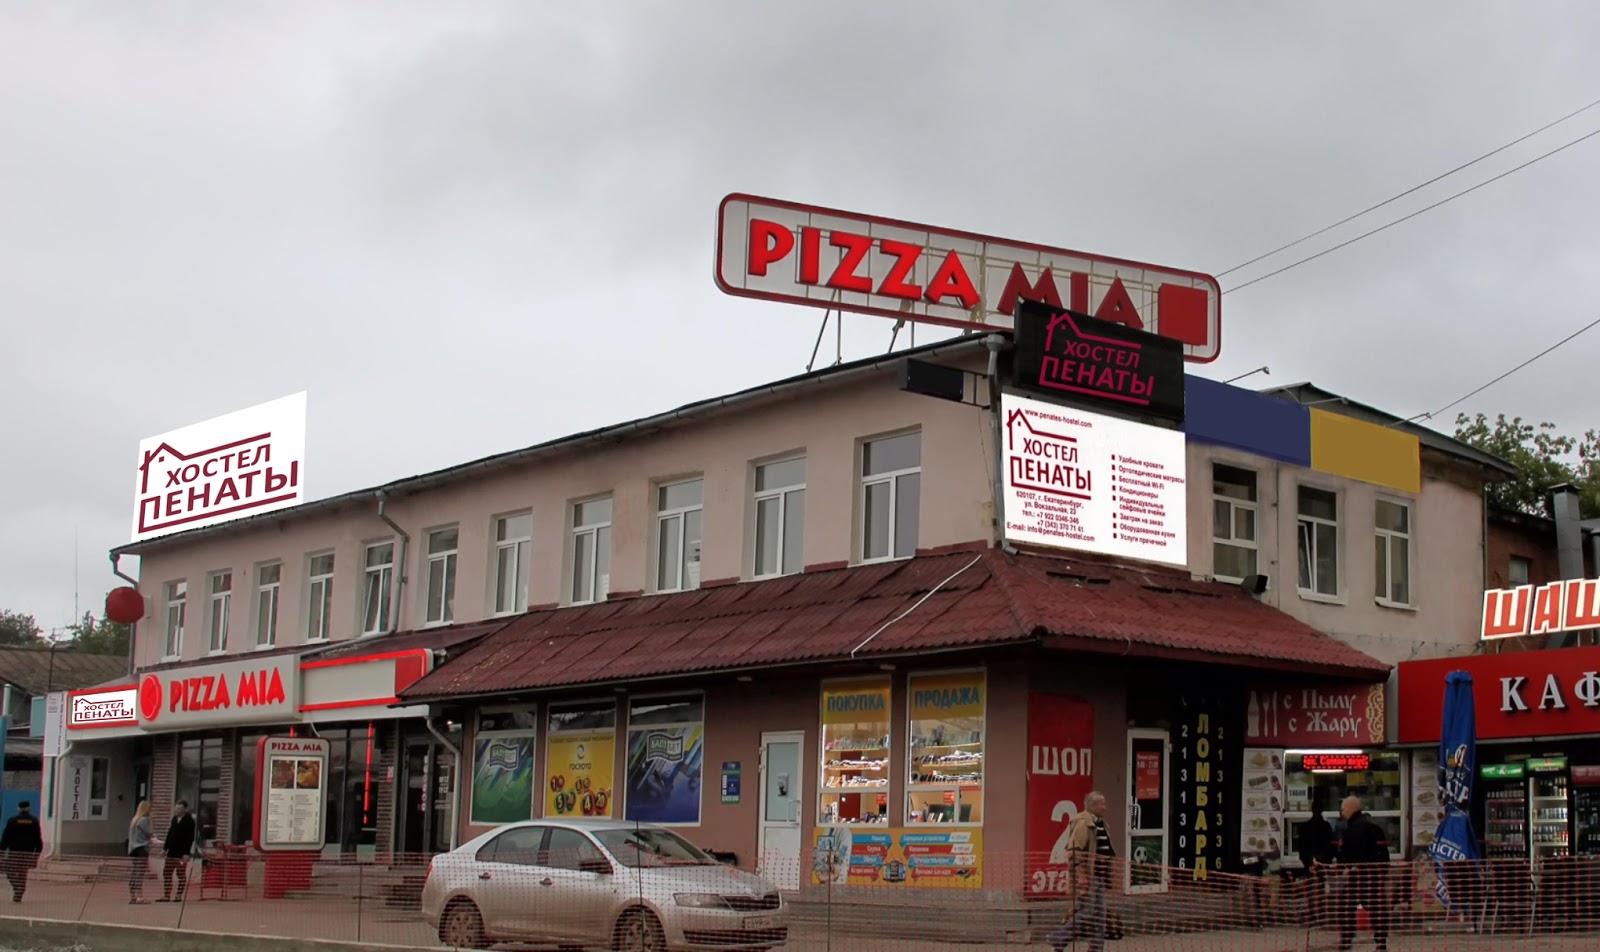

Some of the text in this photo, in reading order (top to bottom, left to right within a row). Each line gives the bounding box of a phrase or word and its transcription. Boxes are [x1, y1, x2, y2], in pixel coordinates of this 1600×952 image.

[748, 218, 1144, 330] PIZZA MIA
[1062, 339, 1140, 369] ХОСТЕЛ
[1038, 356, 1154, 398] ПЕНАТЫ
[1025, 409, 1092, 428] www.penates-hostel.com
[1023, 438, 1078, 463] ХОСТЕЛ
[165, 443, 271, 488] ХОСТЕЛ
[1010, 456, 1091, 491] ПЕНАТЫ
[1119, 455, 1164, 470] Удобные кровати
[139, 460, 298, 524] ПЕНАТЫ
[1119, 475, 1151, 487] Бесплатный
[1016, 490, 1038, 501] 620107,
[1044, 495, 1084, 509] Екатеринбург,
[1119, 486, 1158, 499] Кондиционеры
[1007, 522, 1026, 532] E-mail:
[1045, 520, 1058, 530] (343)
[1060, 522, 1069, 530] 370
[1120, 513, 1141, 522] Завтрак
[1120, 534, 1138, 543] Услуги
[169, 666, 286, 713] PIZZA MIA
[914, 687, 980, 709] ПРОДАЖА
[84, 702, 124, 711] ХОСТЕЛ
[827, 693, 885, 713] ПОКУПКА
[1283, 689, 1356, 715] с Пылу
[74, 708, 133, 720] ПЕНАТЫ
[1288, 712, 1361, 738] с Жару
[272, 742, 322, 752] PIZZA MIA
[71, 767, 81, 820] ХОСТЕЛ
[1193, 713, 1210, 881] ЛОМБАРД
[1032, 870, 1070, 893] эта
